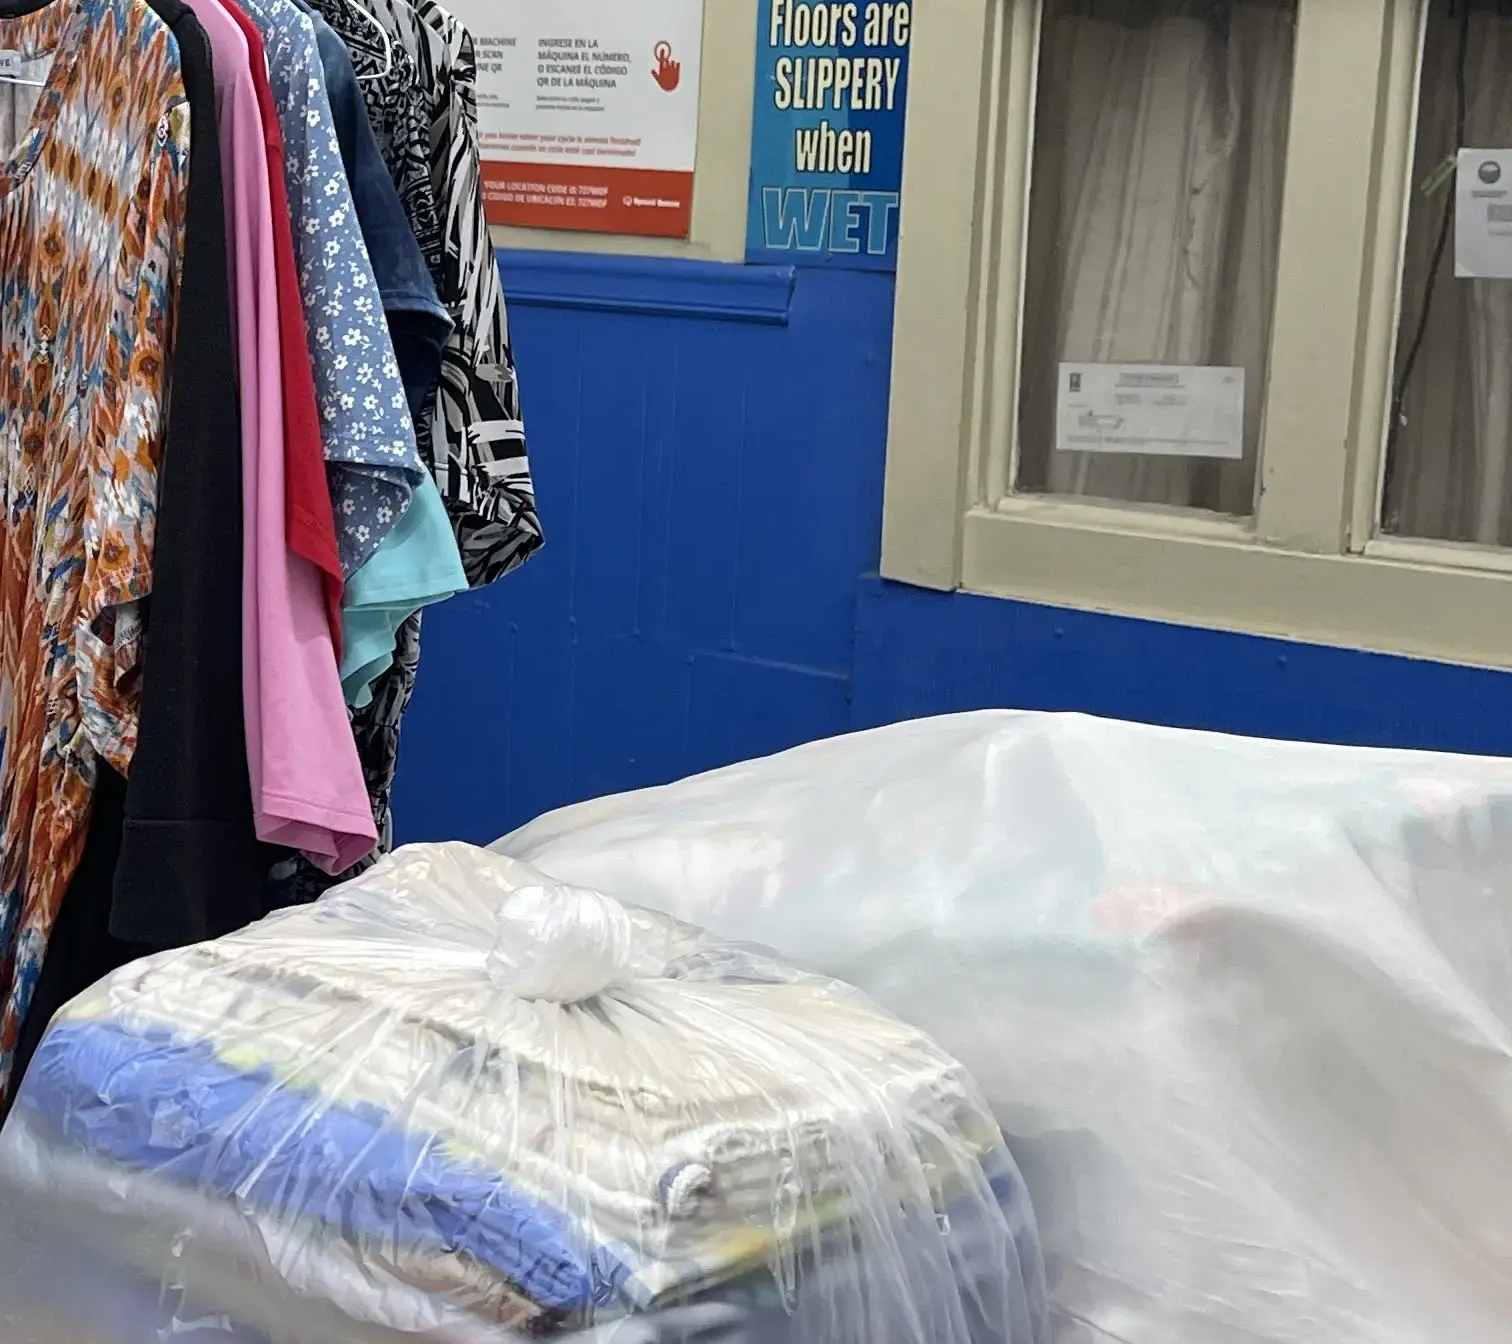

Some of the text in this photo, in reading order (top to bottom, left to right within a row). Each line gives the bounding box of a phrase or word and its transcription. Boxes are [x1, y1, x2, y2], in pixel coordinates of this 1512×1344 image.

[864, 1, 912, 48] are
[774, 57, 901, 110] SLIPPERY
[794, 121, 871, 174] when
[762, 187, 899, 255] WET
